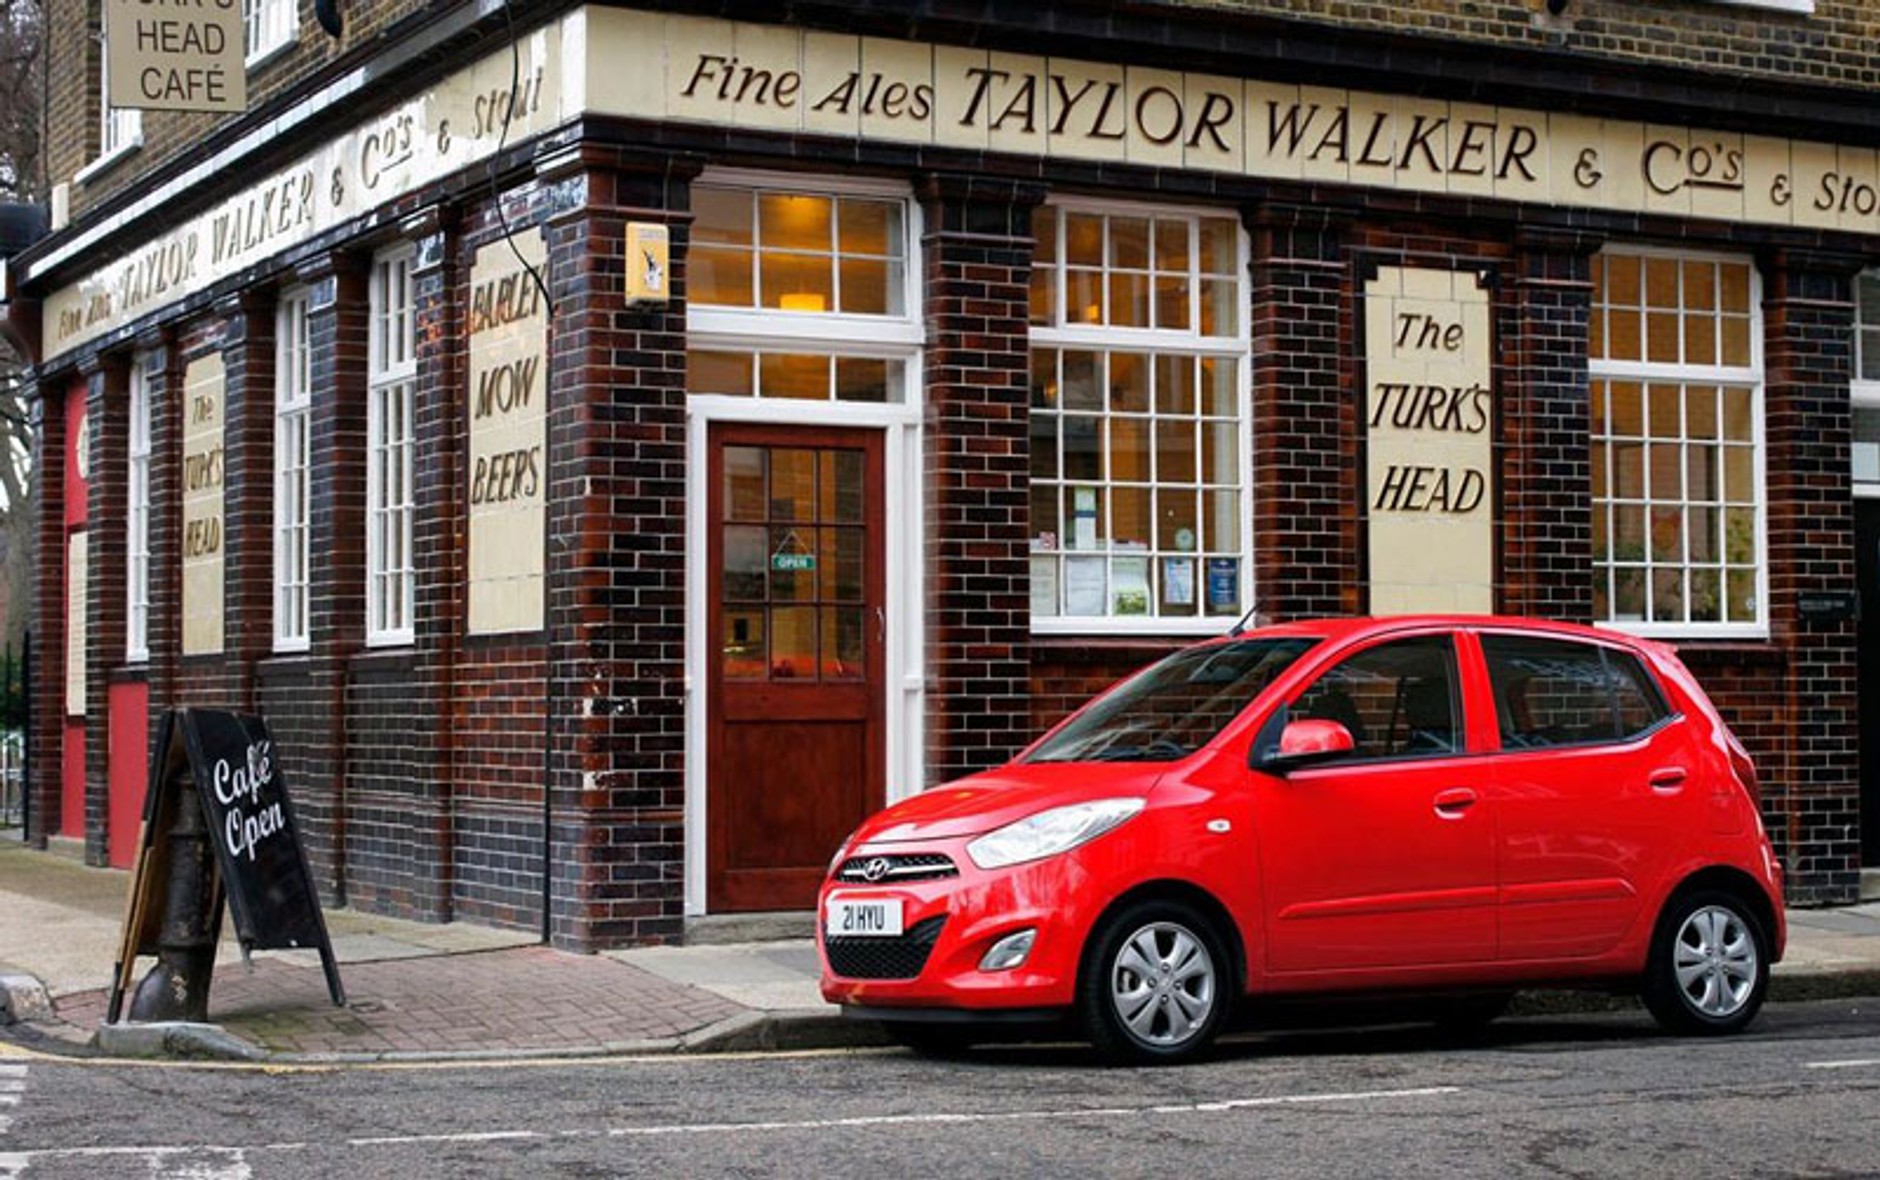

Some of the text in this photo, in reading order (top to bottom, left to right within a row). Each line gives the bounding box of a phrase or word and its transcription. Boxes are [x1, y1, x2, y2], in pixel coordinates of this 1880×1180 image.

[136, 20, 225, 54] HEAD
[141, 64, 227, 102] CAFÉ
[680, 54, 1880, 215] Fine Ales TAYLOR WALKER & Co's & Sto
[120, 231, 198, 311] TAYLOR
[210, 170, 314, 265] WALKER
[331, 166, 344, 206] &
[436, 119, 450, 154] &
[471, 262, 547, 333] BARLEY
[1395, 312, 1464, 352] The
[474, 354, 540, 420] MOW
[1370, 382, 1491, 434] TURK'S
[471, 446, 541, 505] BEERS
[1373, 465, 1485, 514] HEAD
[777, 556, 808, 569] OPEN
[213, 740, 272, 805] Café
[225, 802, 286, 861] Open
[857, 904, 885, 931] HYU
